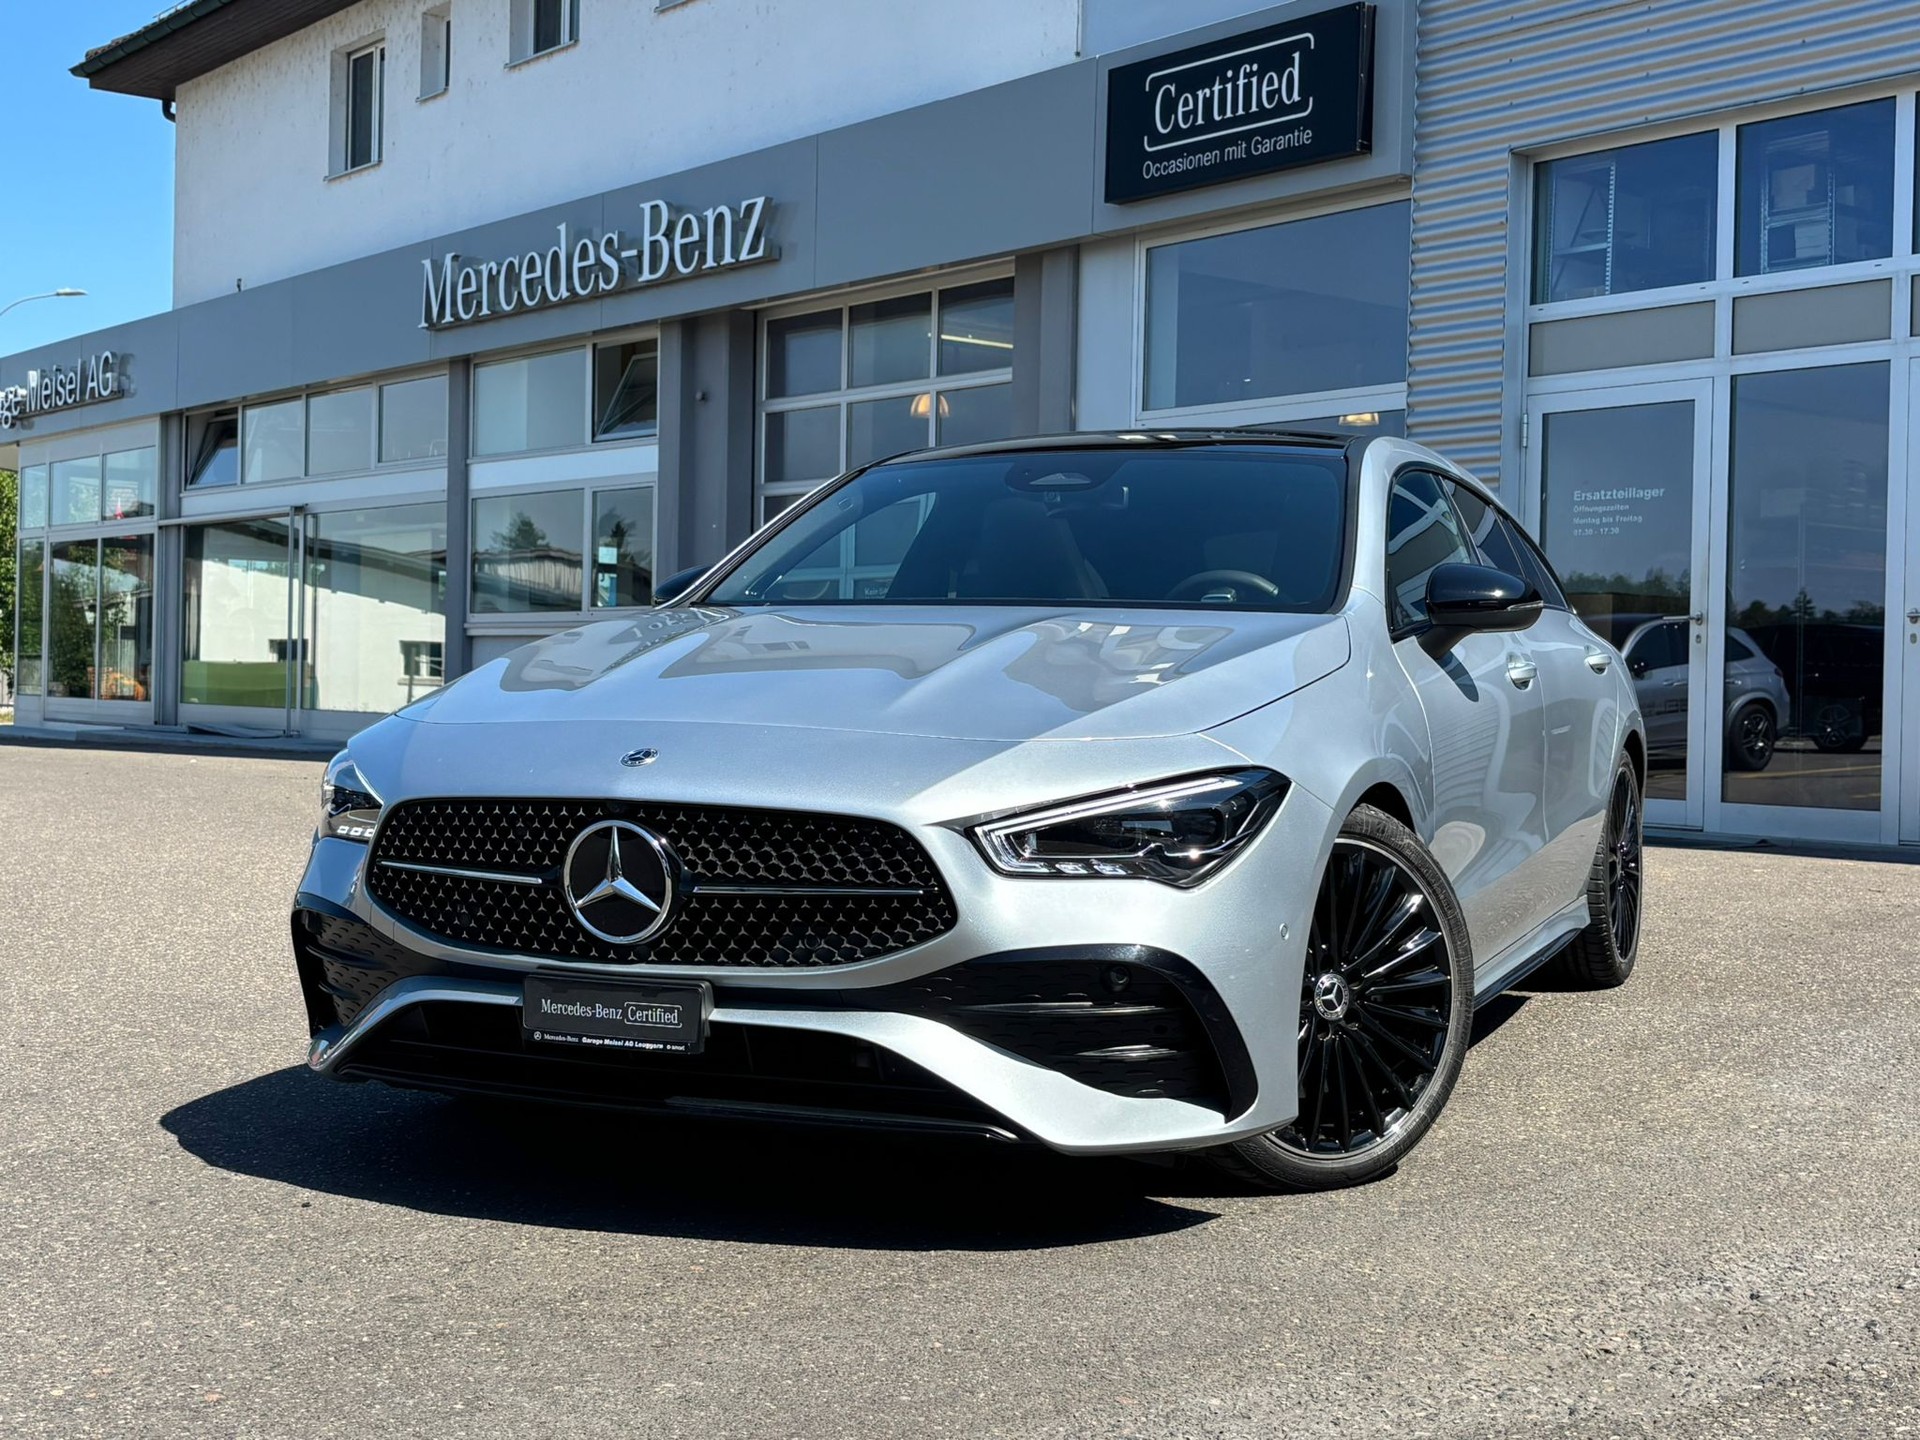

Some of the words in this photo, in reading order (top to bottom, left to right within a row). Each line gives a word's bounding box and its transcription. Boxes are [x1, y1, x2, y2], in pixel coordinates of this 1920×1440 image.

[1155, 51, 1301, 134] Certified
[1143, 150, 1220, 179] Occasionen
[1224, 141, 1247, 162] mit
[1251, 127, 1312, 155] Garantie
[418, 196, 766, 329] Mercedes-Benz
[26, 358, 82, 413] Meisel
[86, 350, 113, 400] AG
[1573, 487, 1665, 501] Ersatzteillager
[541, 998, 623, 1020] Mercedes-Benz
[628, 1006, 679, 1024] Certified
[582, 1037, 603, 1046] Garage
